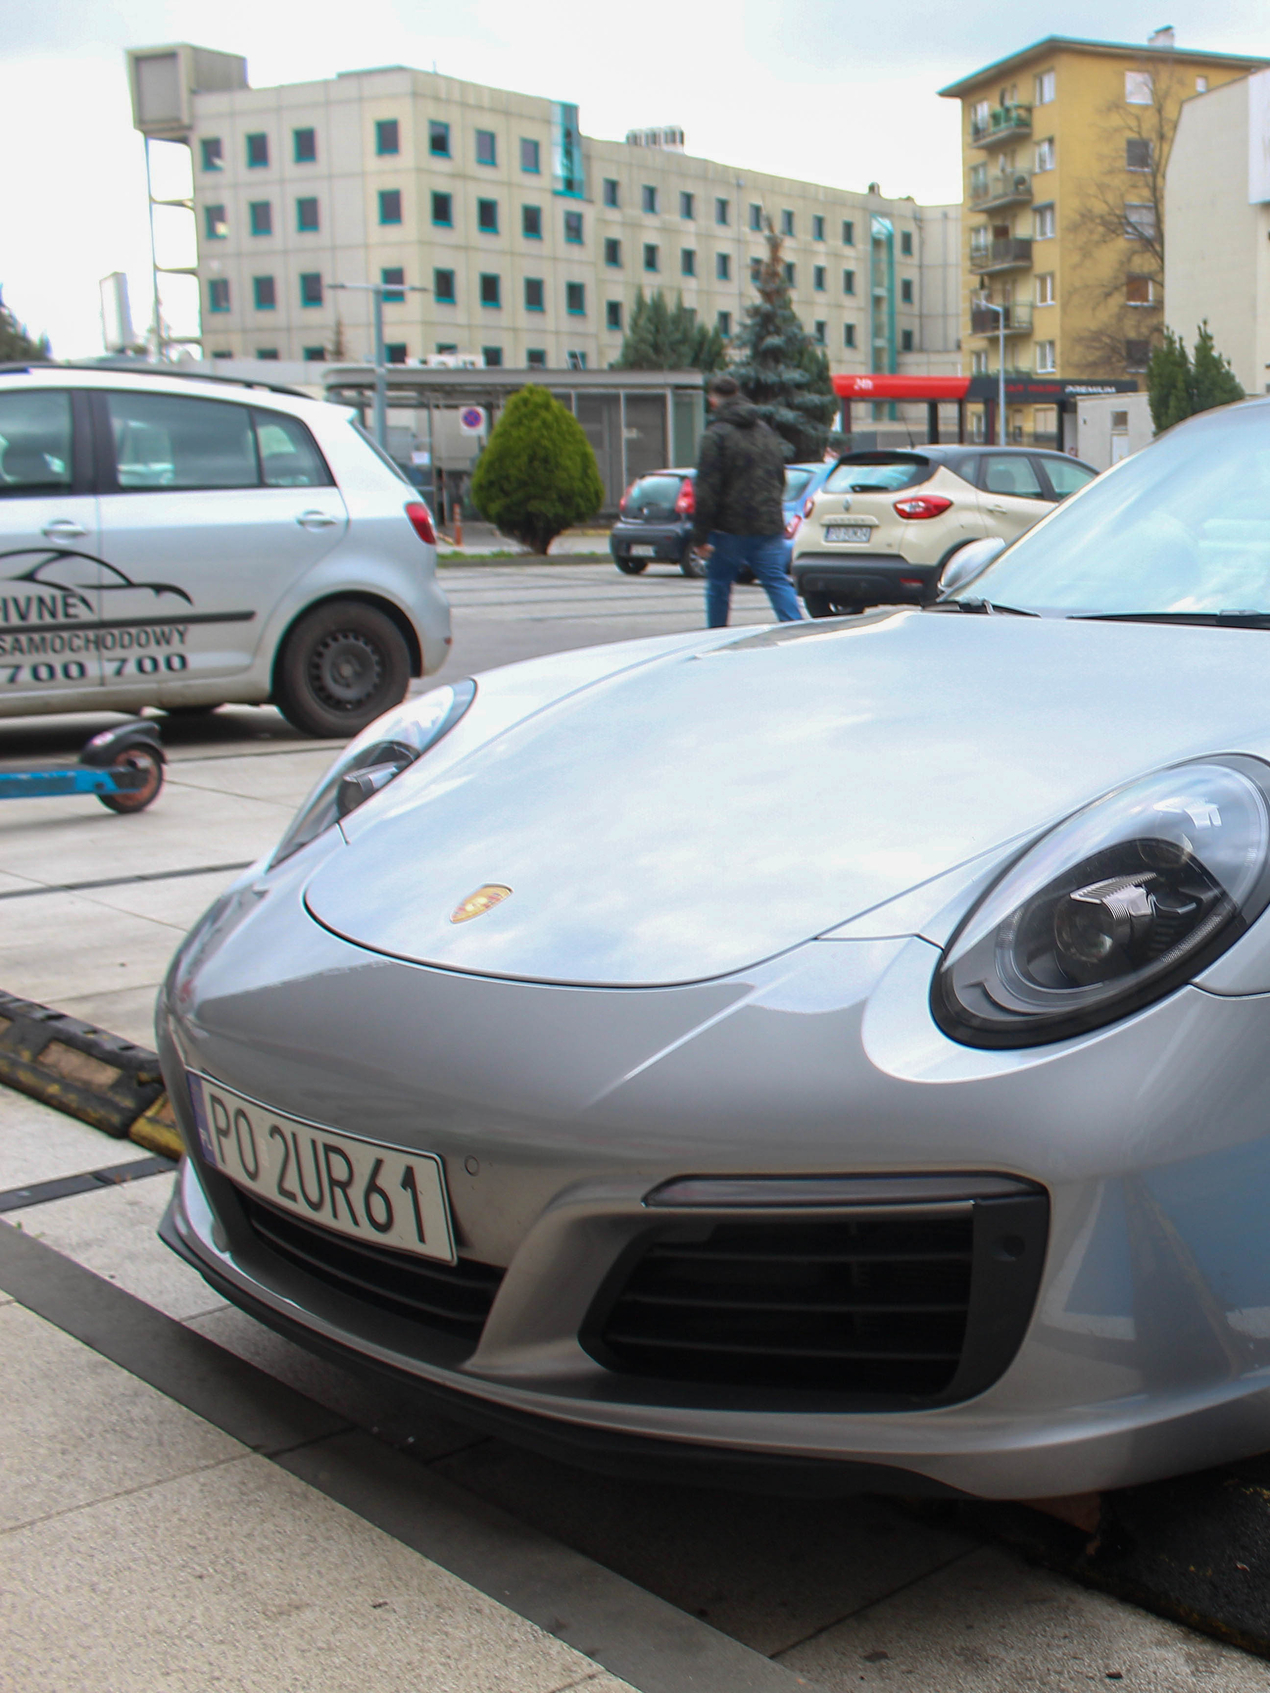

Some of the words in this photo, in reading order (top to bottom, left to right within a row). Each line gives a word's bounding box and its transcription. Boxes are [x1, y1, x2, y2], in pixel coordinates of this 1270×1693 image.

[1004, 384, 1024, 393] AR
[1065, 384, 1116, 395] PREMIUM
[0, 626, 188, 657] SAMOCHODOWY
[0, 660, 87, 684] 700
[106, 653, 188, 677] 700
[209, 1092, 259, 1182] PO
[269, 1124, 427, 1245] 2UR61
